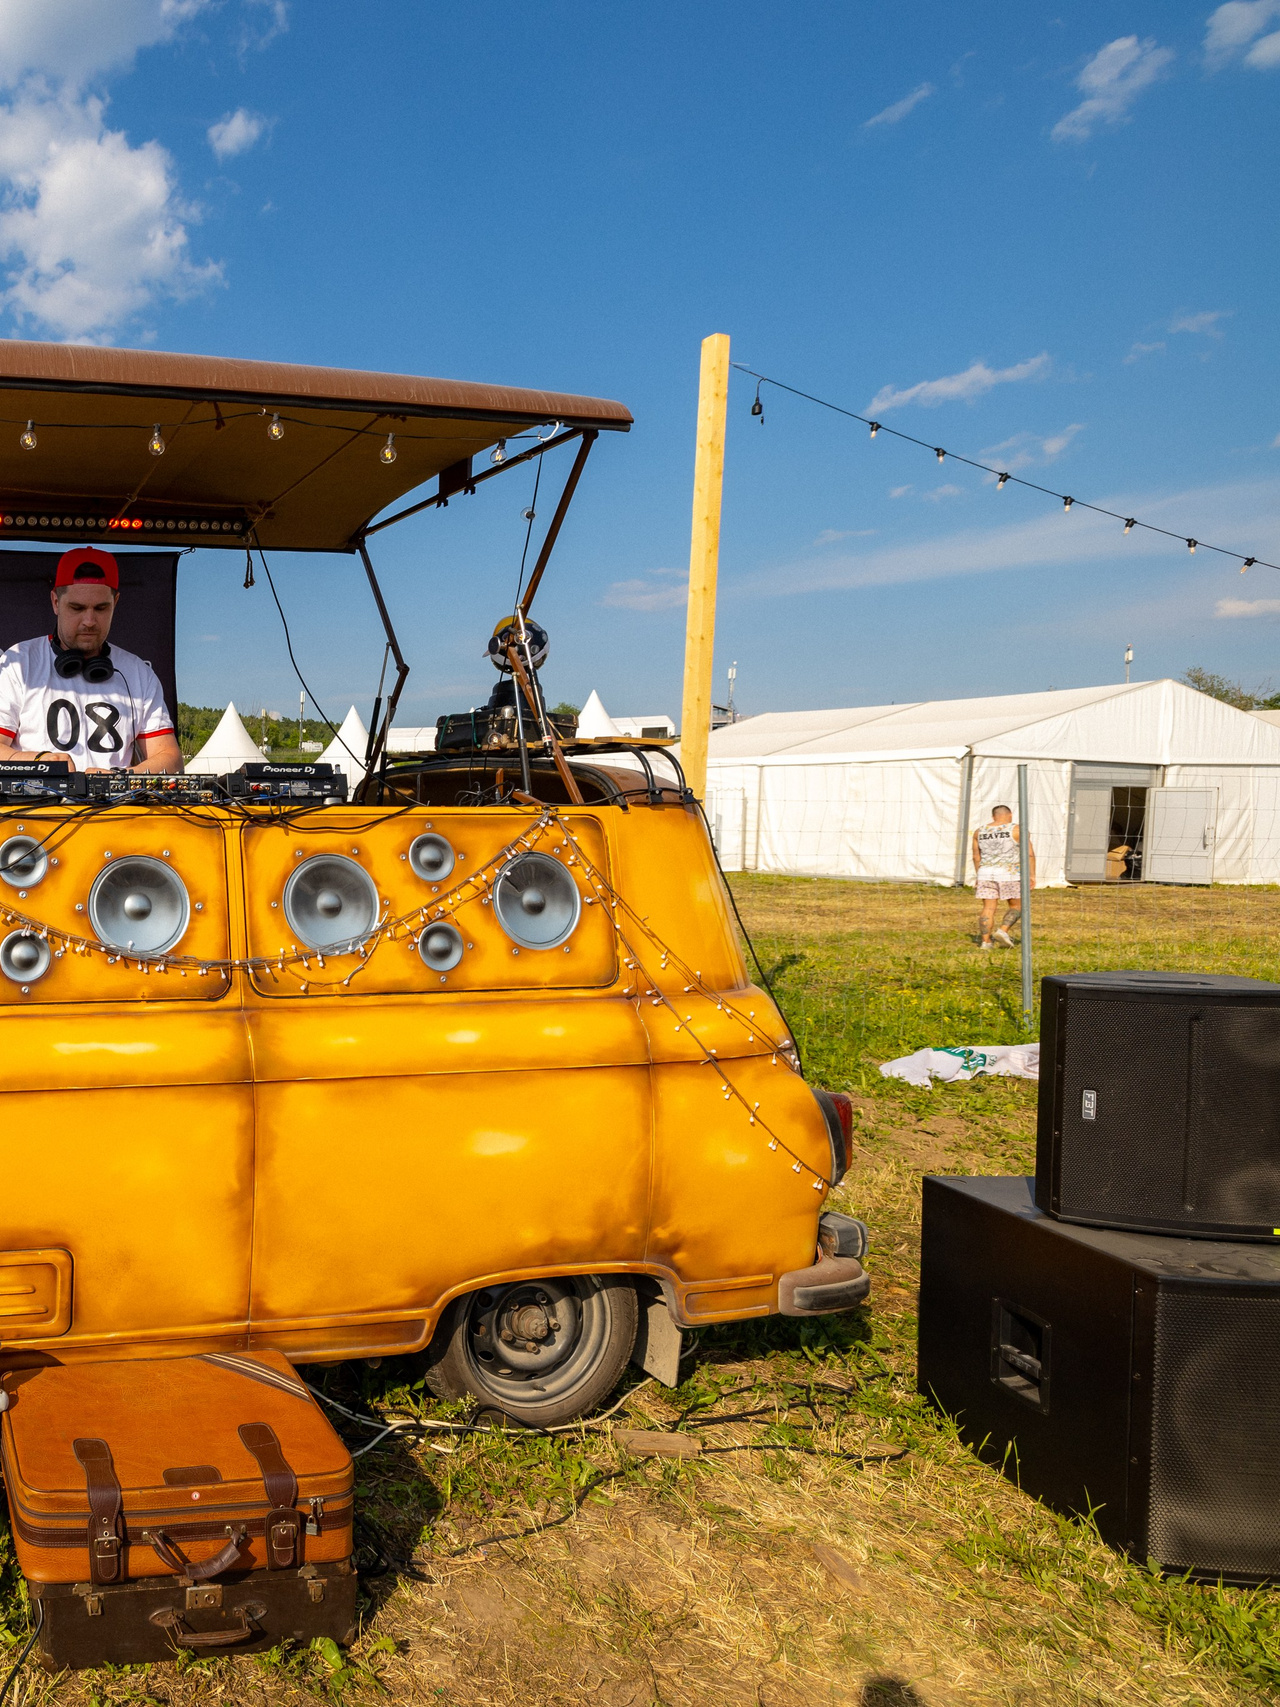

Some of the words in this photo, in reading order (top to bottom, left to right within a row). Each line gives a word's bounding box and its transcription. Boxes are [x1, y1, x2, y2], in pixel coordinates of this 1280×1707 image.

[46, 698, 124, 753] 08
[262, 765, 303, 773] Pioneer
[1084, 1092, 1095, 1117] FBT
